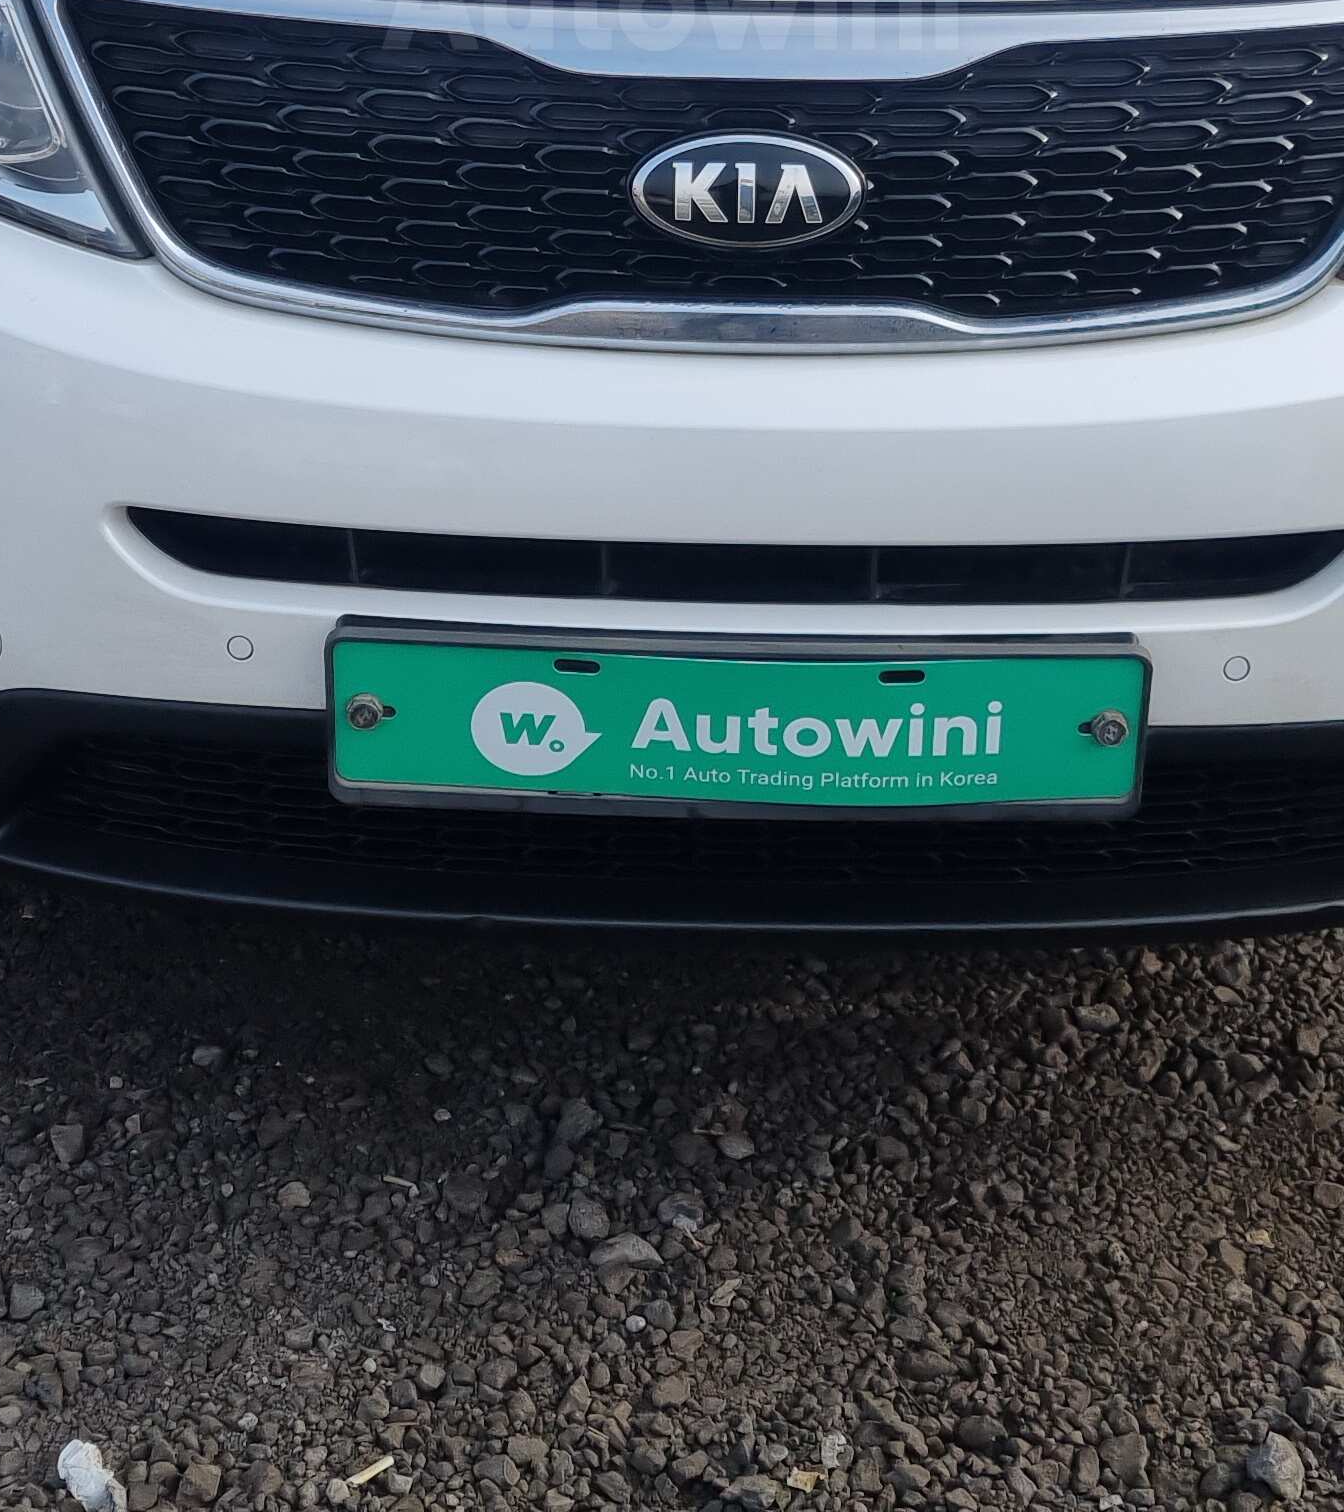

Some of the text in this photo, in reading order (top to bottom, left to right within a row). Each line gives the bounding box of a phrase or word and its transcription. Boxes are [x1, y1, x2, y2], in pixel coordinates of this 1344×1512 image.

[672, 161, 824, 224] KIA
[631, 697, 1003, 758] Autowini
[629, 763, 998, 790] No.1 Auto Trading Platform in Korea
